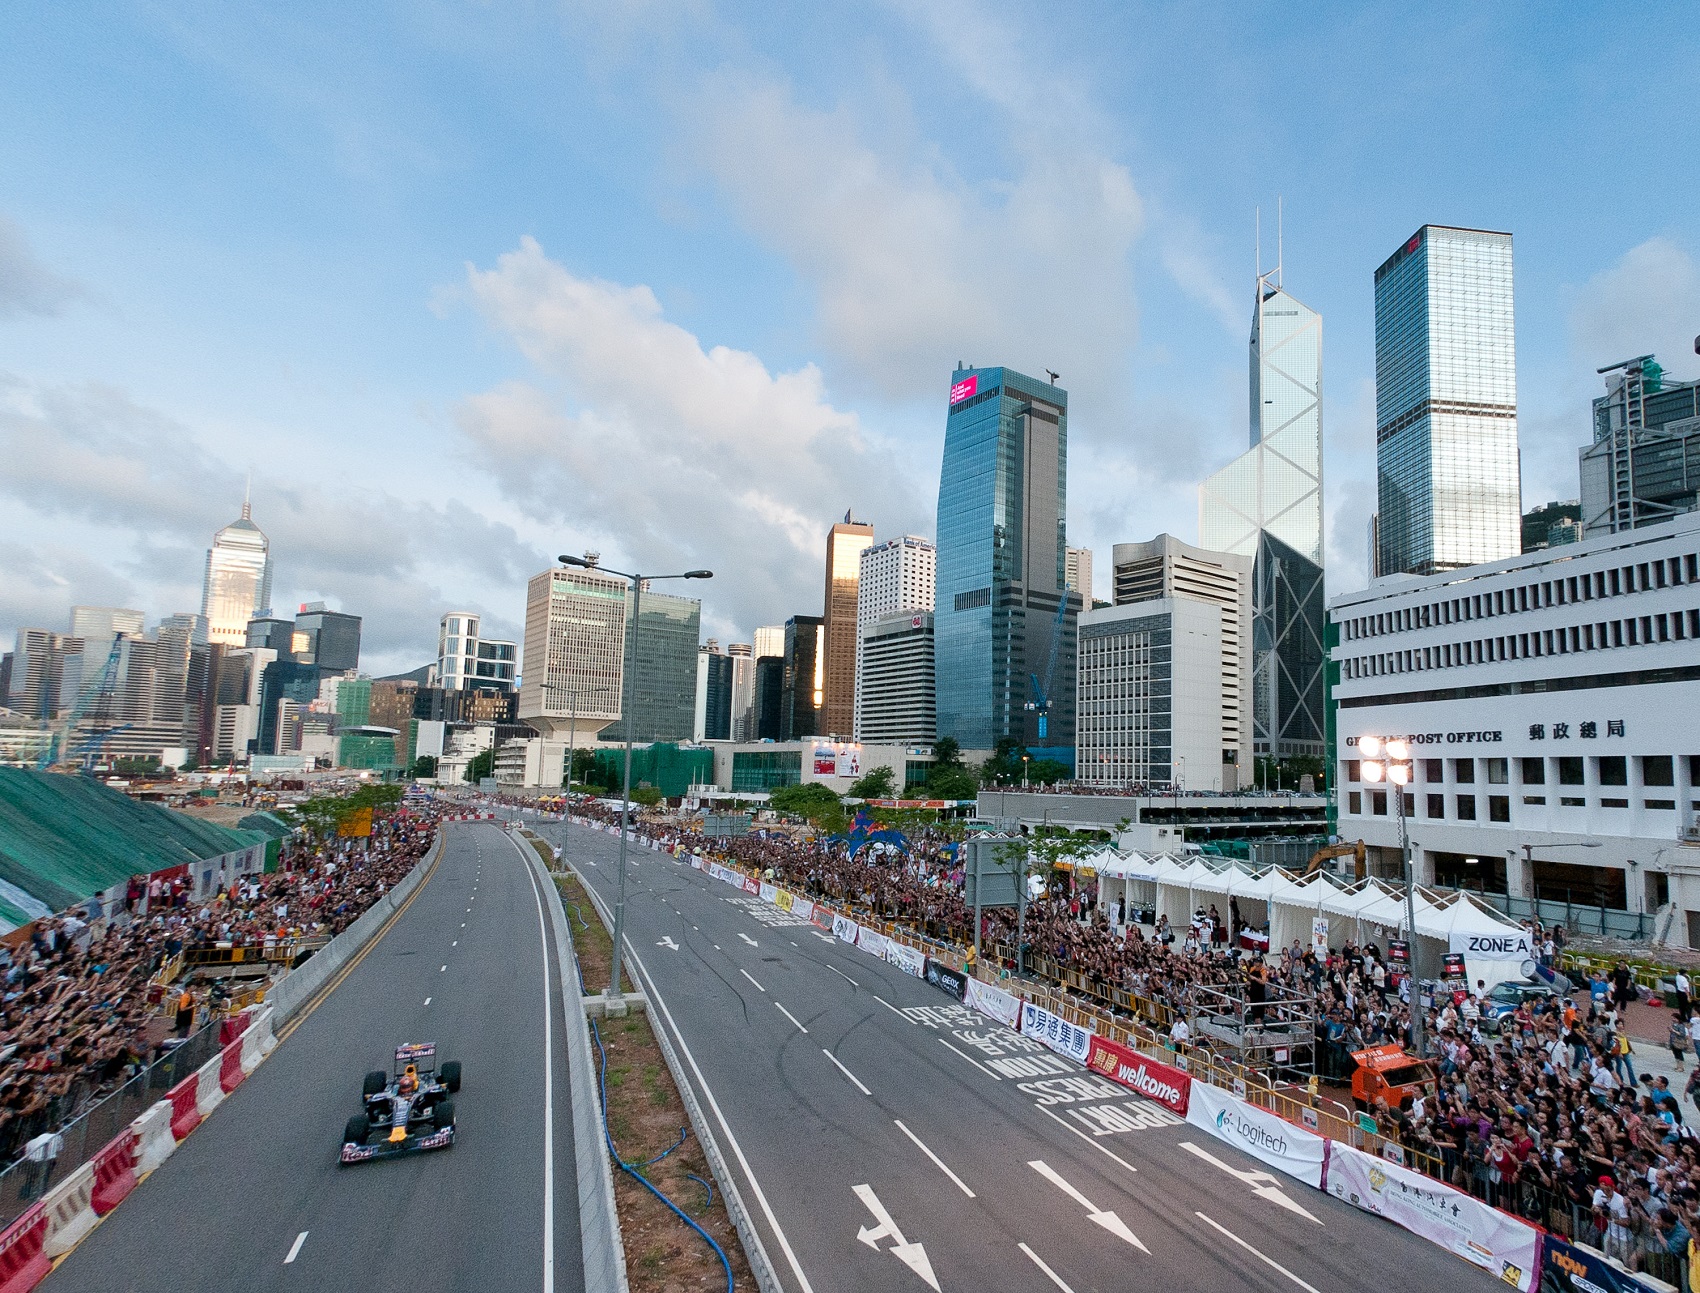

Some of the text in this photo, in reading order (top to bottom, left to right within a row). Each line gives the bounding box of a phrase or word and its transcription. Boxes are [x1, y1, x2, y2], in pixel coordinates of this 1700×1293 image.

[904, 537, 914, 545] Bank
[1408, 733, 1443, 744] POST
[1446, 730, 1502, 743] OFFICE
[1529, 719, 1625, 741] 郵政總局
[1469, 937, 1528, 953] ZONE A
[942, 974, 960, 990] GEOX
[901, 1004, 990, 1029] 綫站
[1036, 1008, 1085, 1056] 易通集團
[984, 1054, 1081, 1079] ATION
[1092, 1047, 1119, 1073] 惠康
[1017, 1074, 1136, 1105] PRESS
[1118, 1063, 1181, 1104] wellcome
[1066, 1100, 1187, 1136] RPORT
[1237, 1117, 1288, 1155] Logitech
[1551, 1250, 1588, 1278] now
